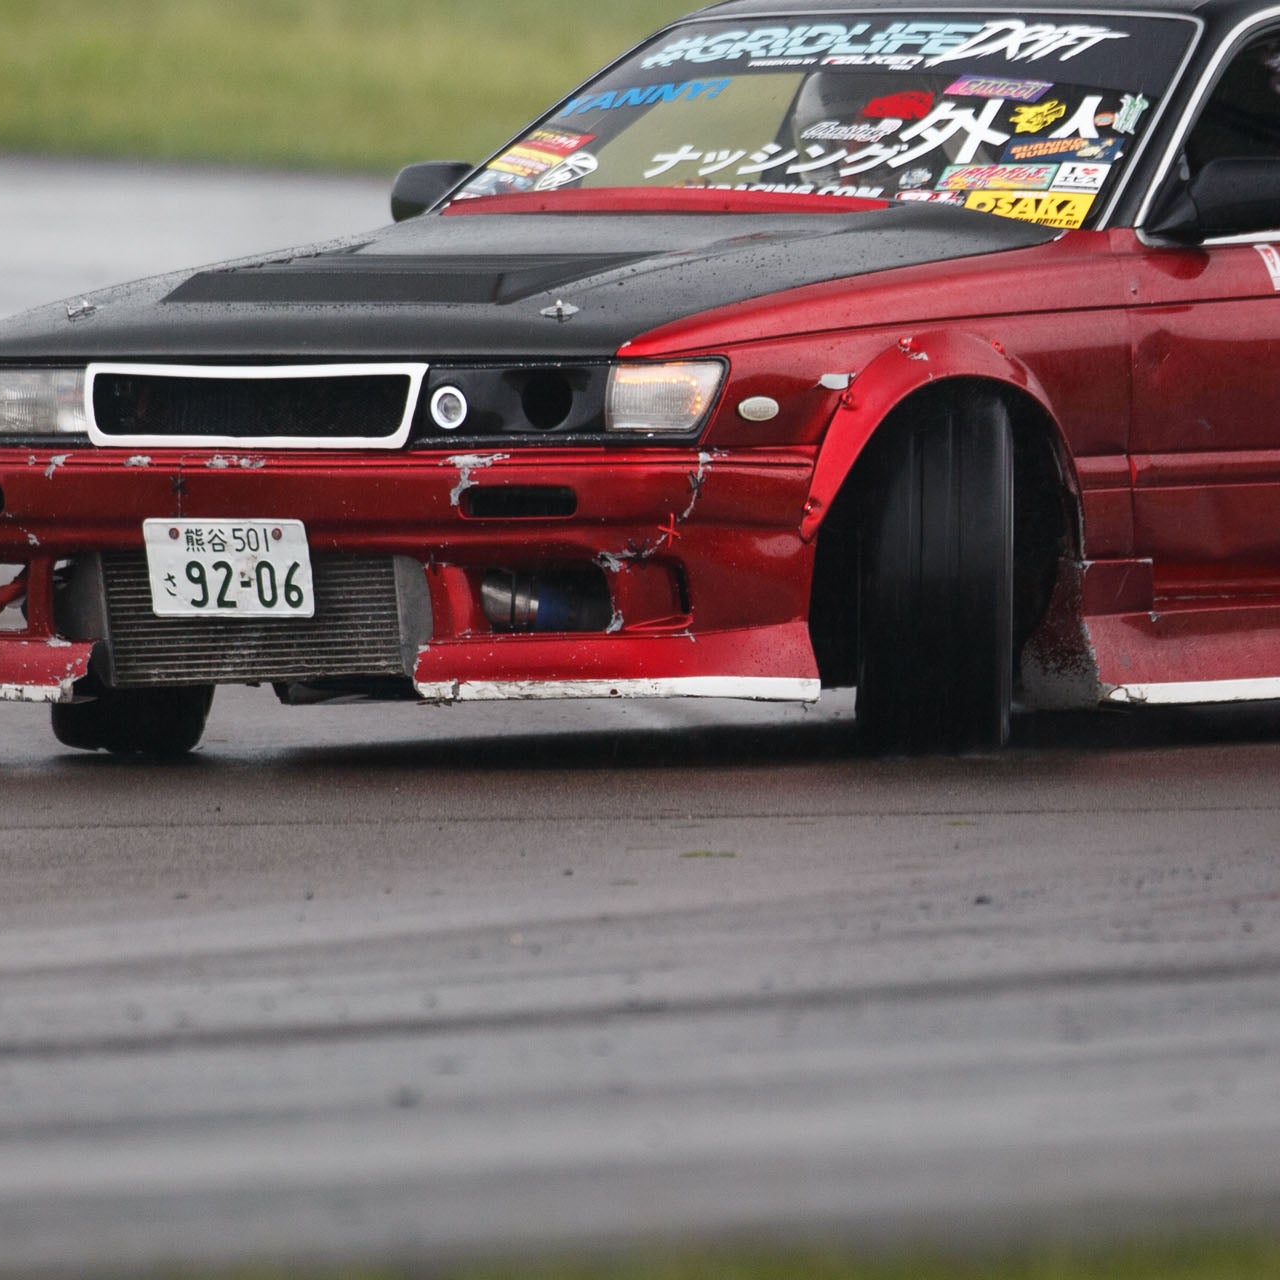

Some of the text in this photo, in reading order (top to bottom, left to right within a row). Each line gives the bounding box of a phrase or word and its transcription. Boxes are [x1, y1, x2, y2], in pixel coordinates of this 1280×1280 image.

[923, 19, 1131, 69] DRIFT
[820, 54, 924, 66] FALKEN
[1010, 138, 1085, 154] BURNING
[1015, 144, 1082, 160] RUBBER
[1060, 175, 1098, 185] エビス
[974, 196, 1081, 218] OSAKA
[184, 527, 270, 553] 熊谷 501
[163, 559, 305, 610] さ 92-06
